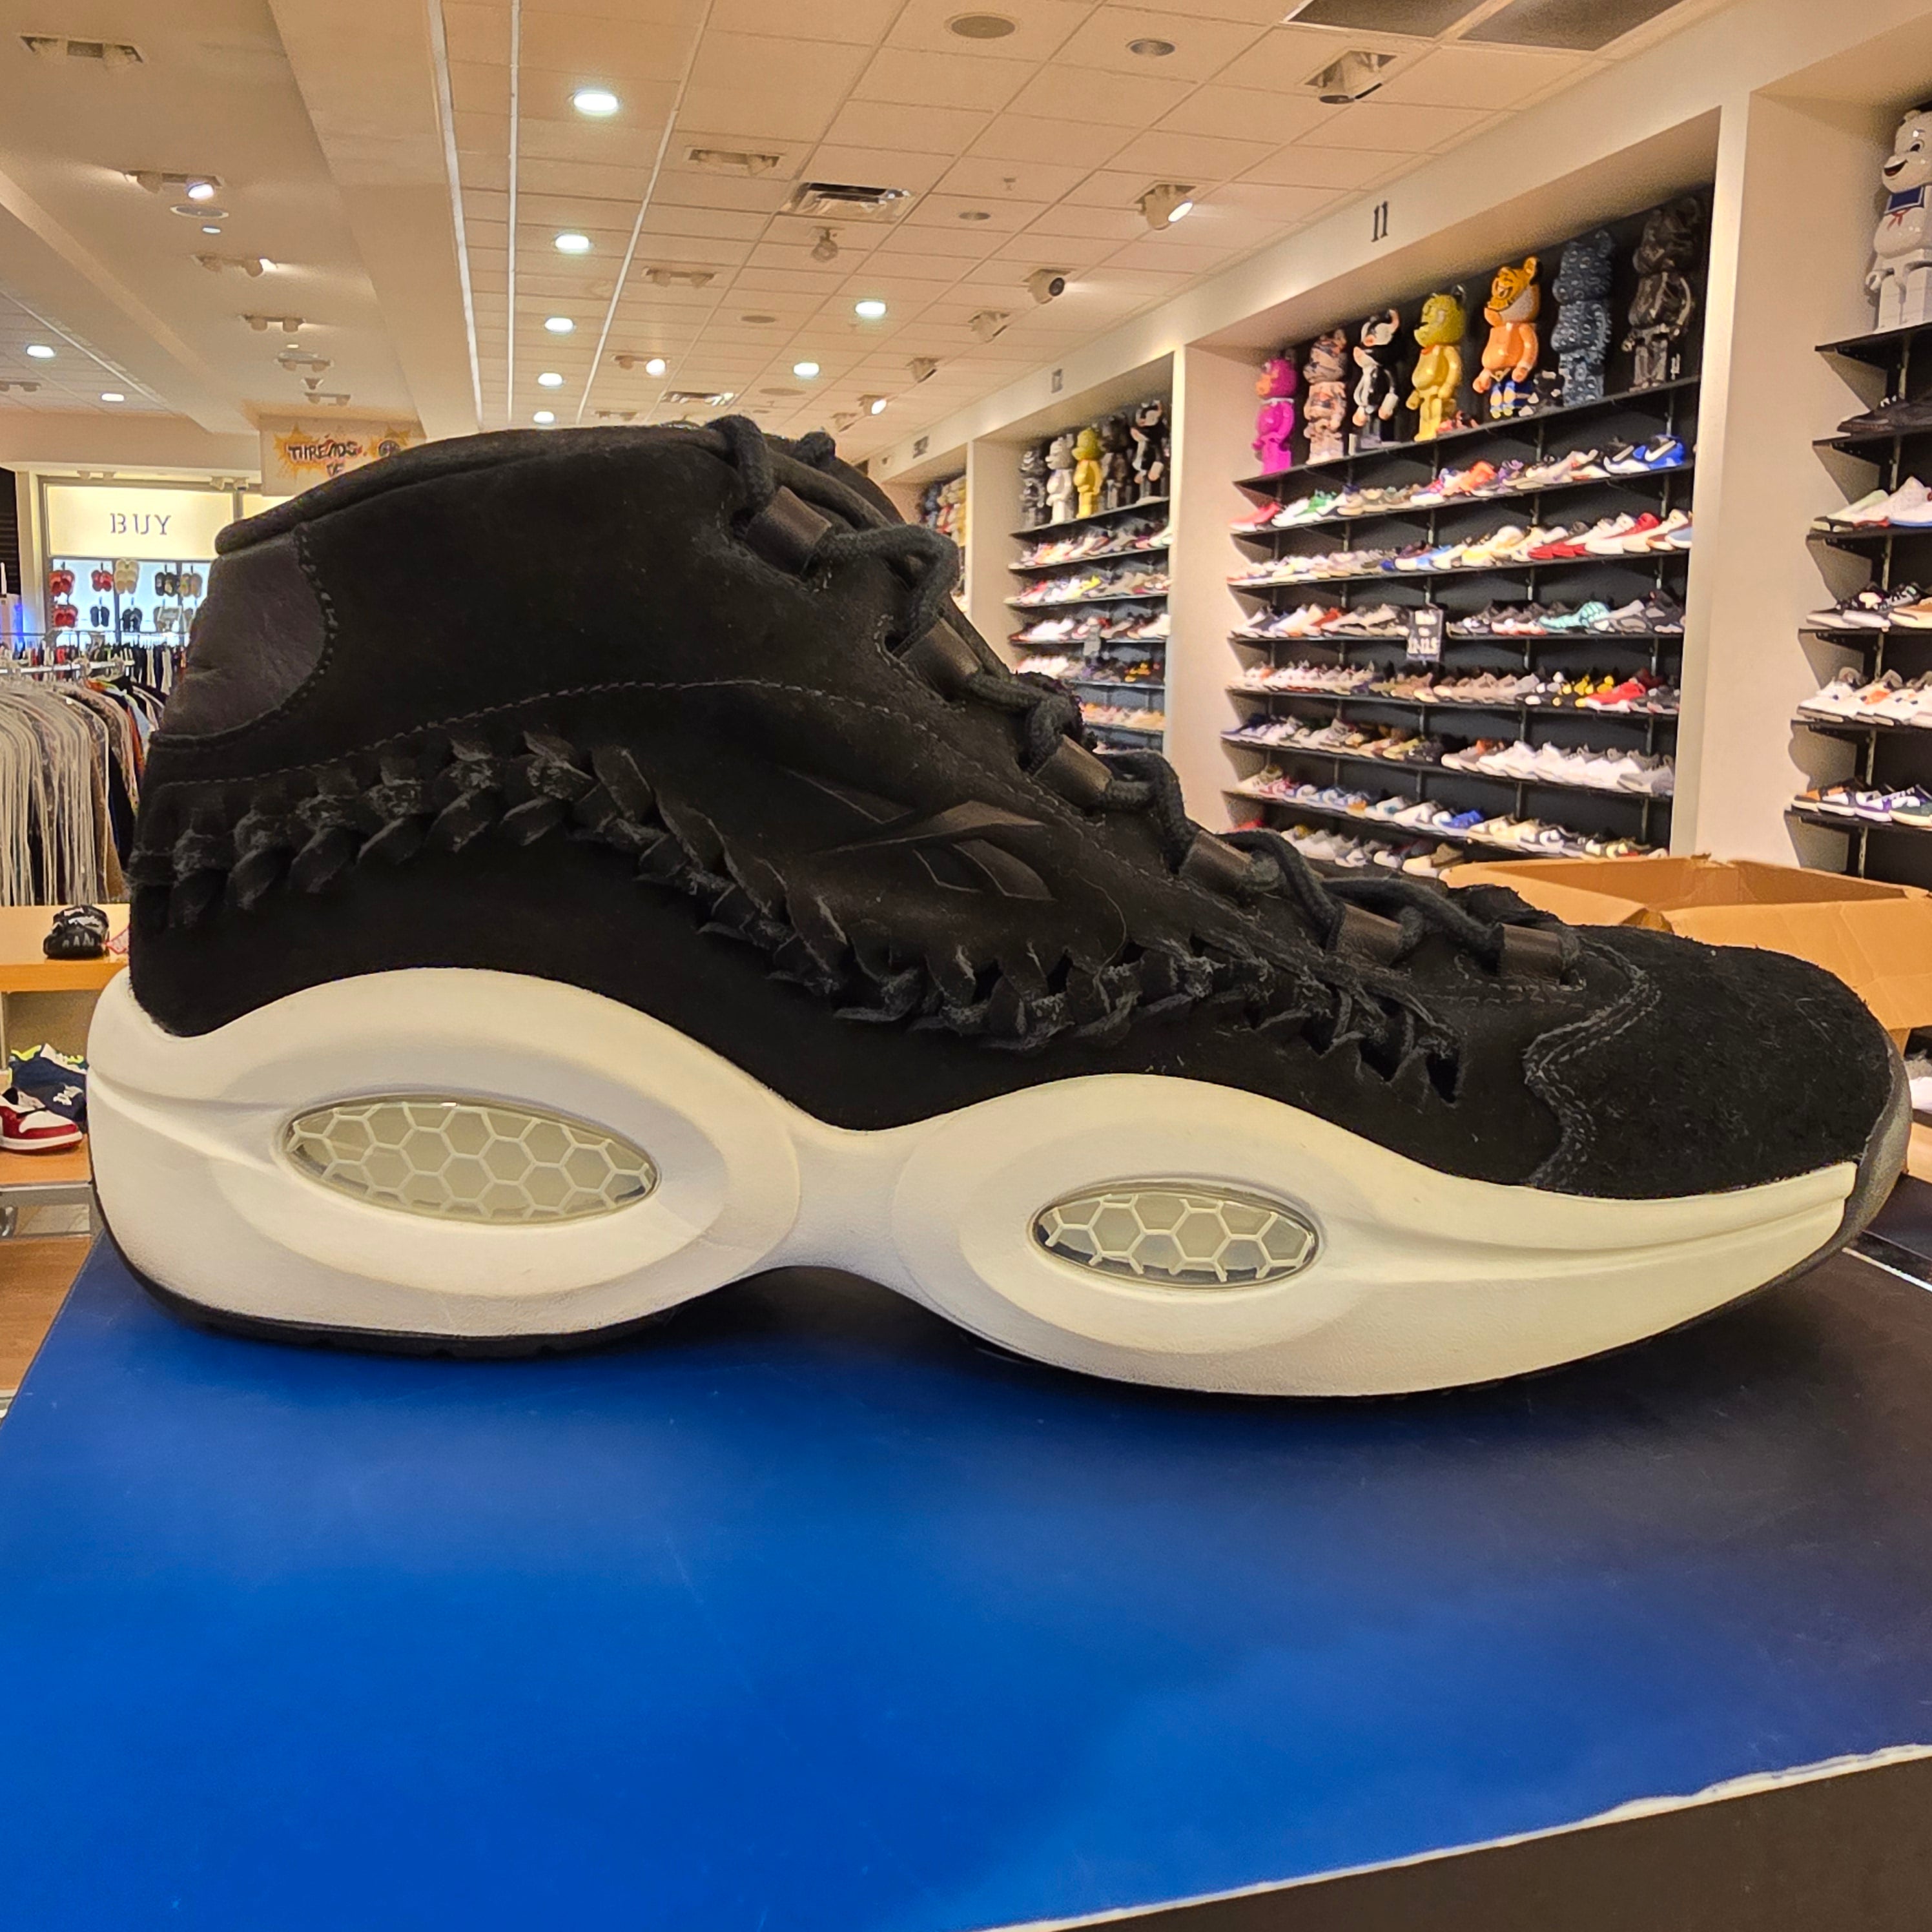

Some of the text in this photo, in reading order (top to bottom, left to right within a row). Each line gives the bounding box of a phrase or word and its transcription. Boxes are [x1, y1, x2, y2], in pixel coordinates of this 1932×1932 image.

[1371, 200, 1388, 242] 11
[288, 440, 358, 460] THREADS
[110, 513, 172, 535] BUY
